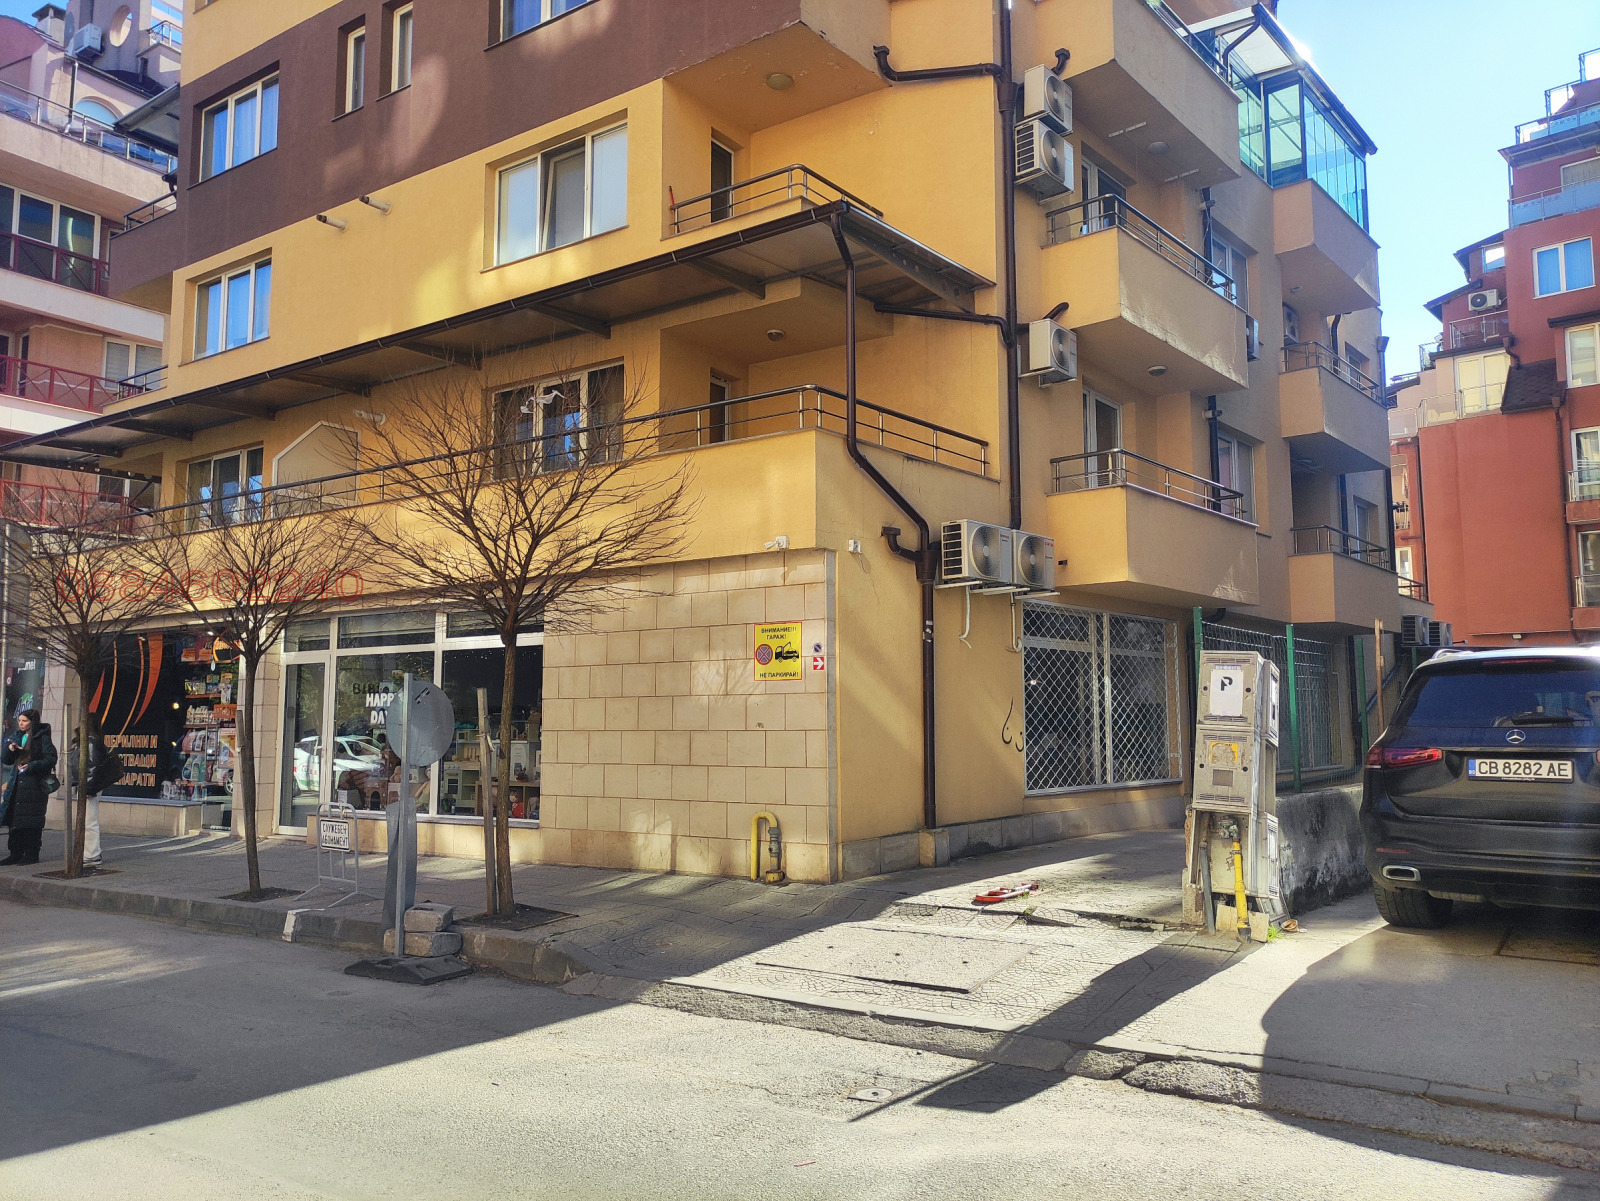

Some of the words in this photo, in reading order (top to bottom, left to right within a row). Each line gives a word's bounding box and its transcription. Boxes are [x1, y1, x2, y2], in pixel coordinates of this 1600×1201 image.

[1220, 676, 1233, 691] P
[366, 692, 397, 708] HAPP
[371, 710, 388, 724] DA
[1478, 760, 1499, 775] CB
[1502, 761, 1543, 776] 8282
[1547, 762, 1569, 777] AE
